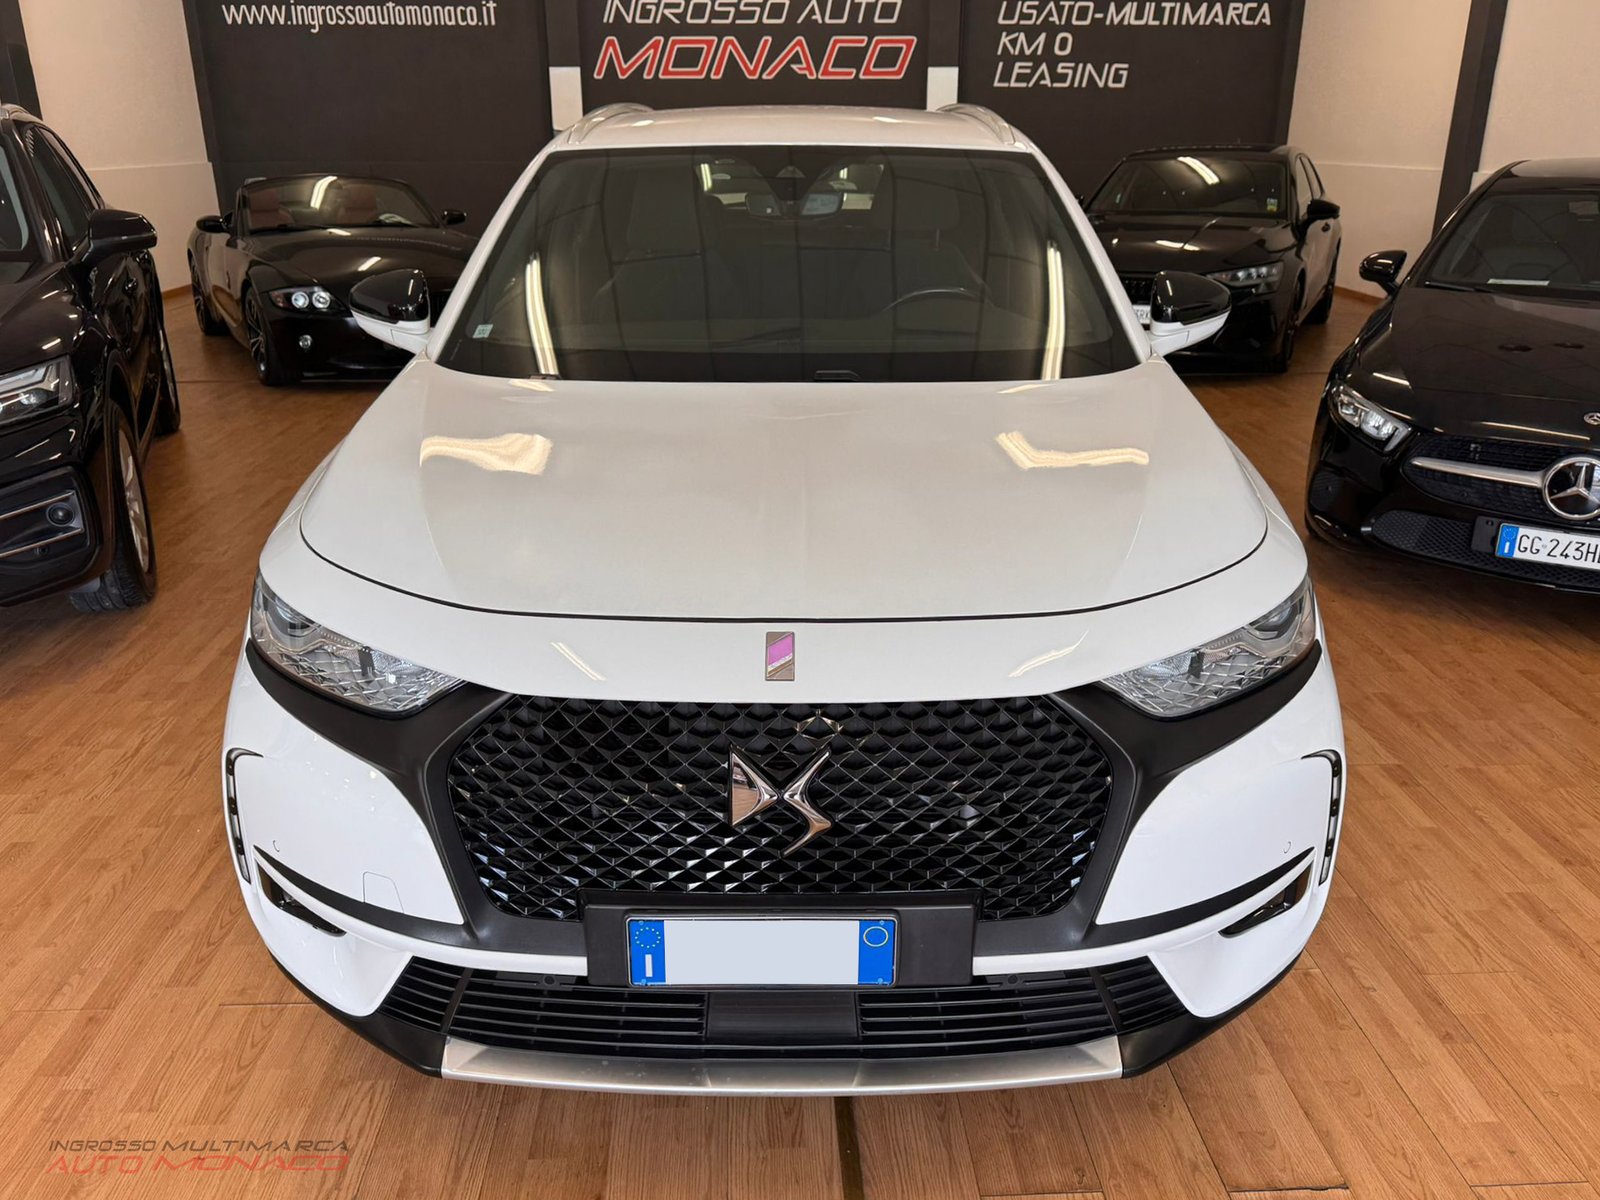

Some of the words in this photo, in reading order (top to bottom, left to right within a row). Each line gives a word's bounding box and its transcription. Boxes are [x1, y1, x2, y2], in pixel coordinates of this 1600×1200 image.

[221, 0, 498, 33] www.ingrossoautomonaco.it
[602, 0, 790, 24] INGROSSO
[796, 0, 903, 24] AUTO
[997, 0, 1272, 26] USATO-MULTIMARCA
[593, 35, 918, 80] MONACO
[997, 32, 1046, 56] KM
[992, 61, 1130, 88] LEASING
[1517, 534, 1542, 555] GG
[1547, 538, 1600, 563] 243H
